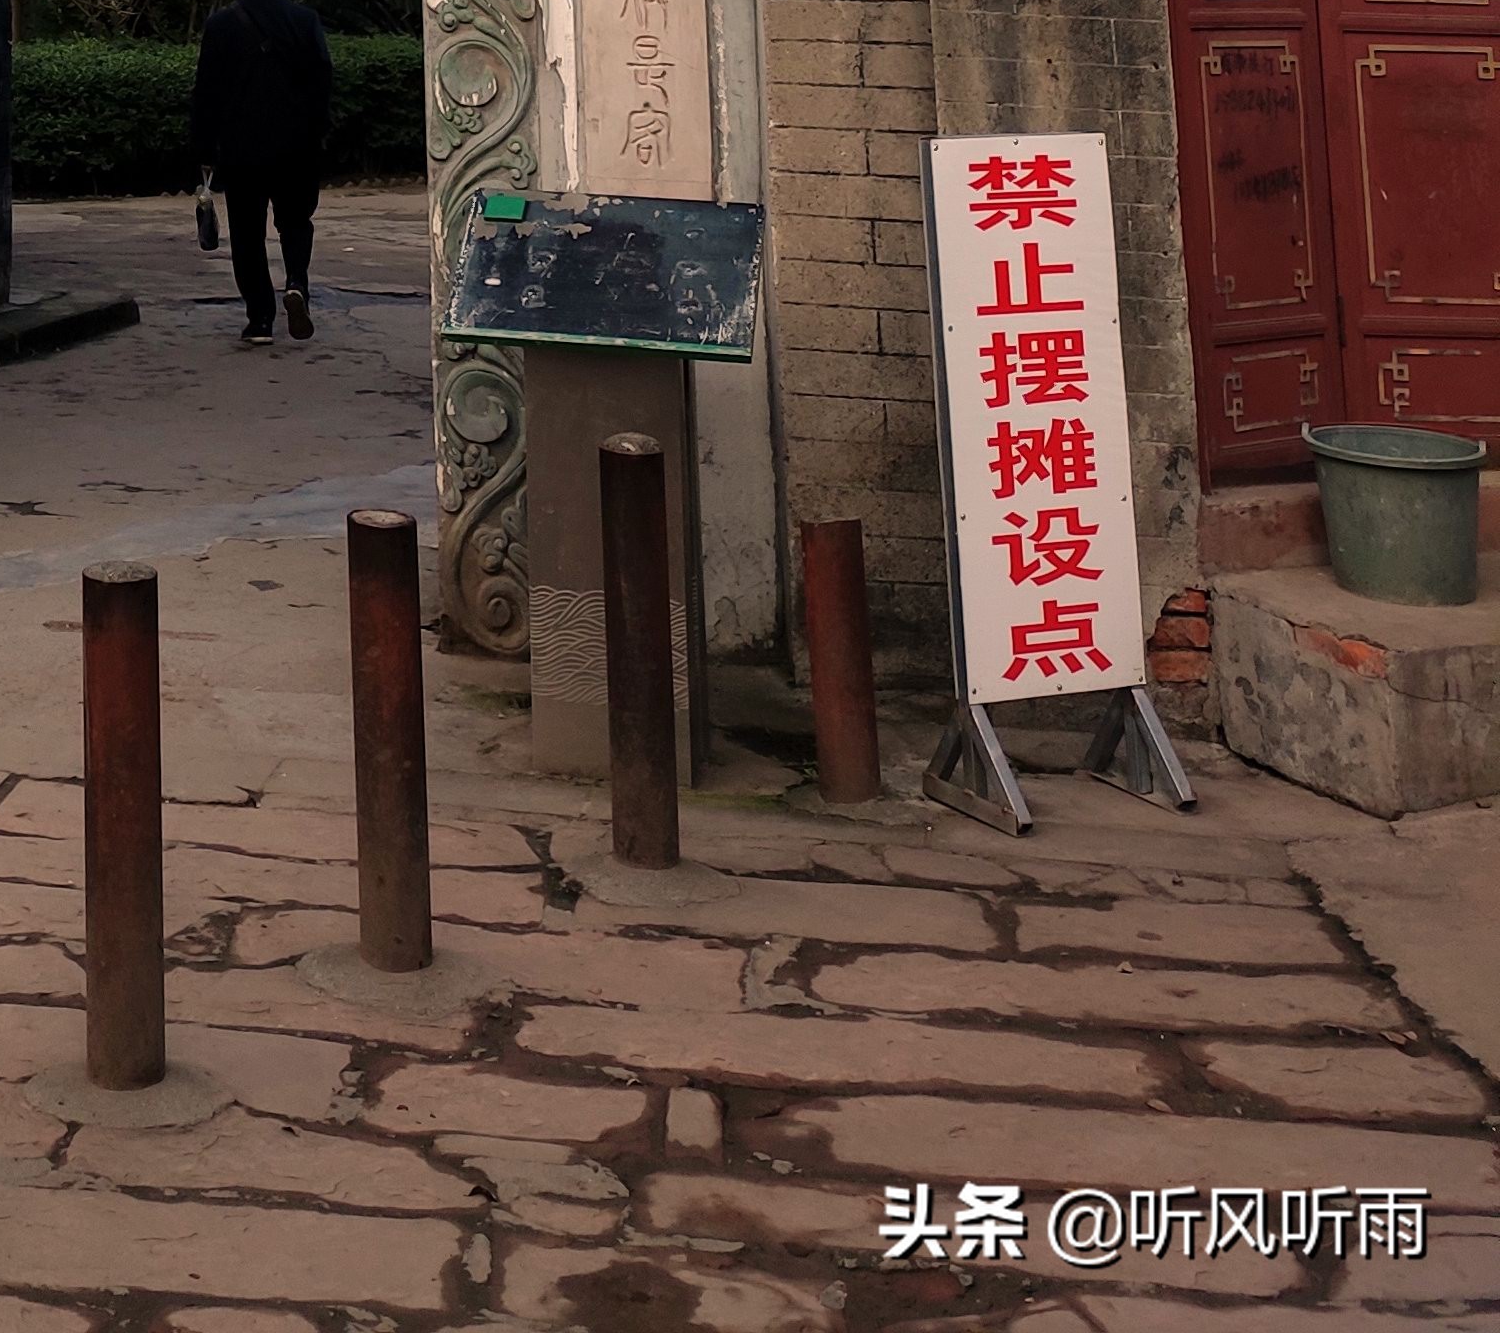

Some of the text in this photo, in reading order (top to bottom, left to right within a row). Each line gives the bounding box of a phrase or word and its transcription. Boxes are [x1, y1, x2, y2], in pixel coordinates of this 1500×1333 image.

[967, 154, 1113, 682] 禁止摆摊设点
